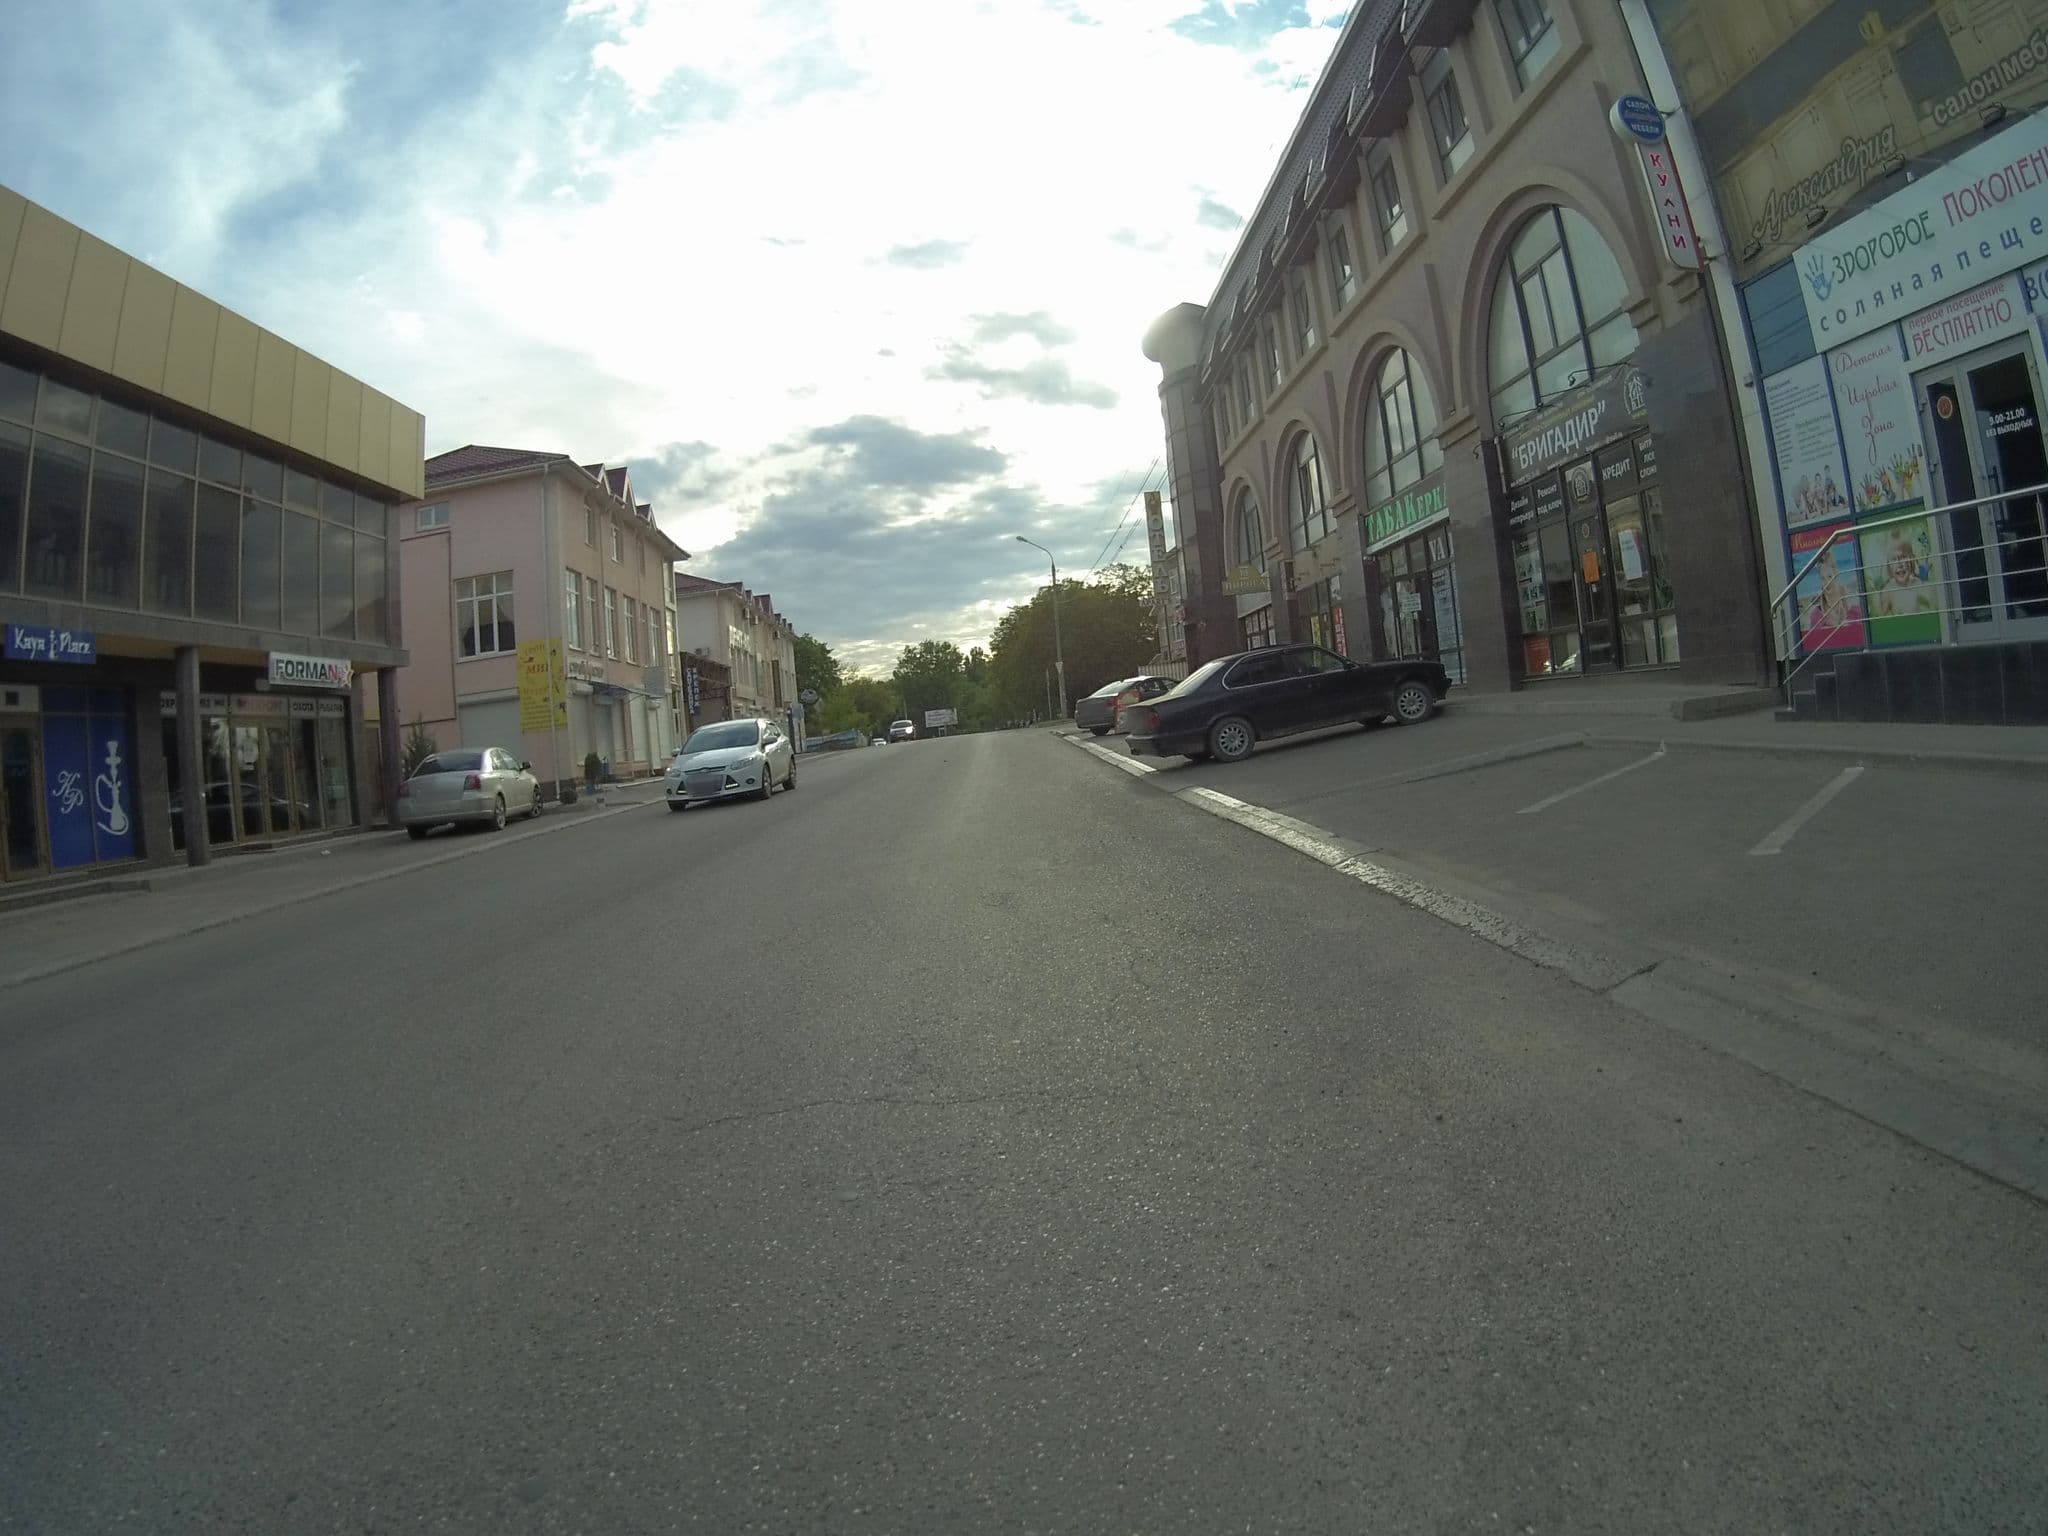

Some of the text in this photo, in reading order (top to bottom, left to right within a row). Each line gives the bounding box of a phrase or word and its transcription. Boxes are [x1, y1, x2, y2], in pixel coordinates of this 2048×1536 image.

[1933, 28, 2048, 125] салон меб
[1832, 210, 1935, 284] ЗДОРОВОЕ
[1820, 216, 2043, 331] соляная пеще
[1909, 283, 2005, 330] первое посещение
[1911, 298, 2011, 355] БЕСПЛАТНО
[1835, 344, 1893, 375] Детская
[1862, 415, 1895, 465] Зона
[1989, 407, 2025, 426] 9.00-21.00
[1602, 458, 1631, 481] КРЕДИТ
[15, 627, 45, 660] Kaya
